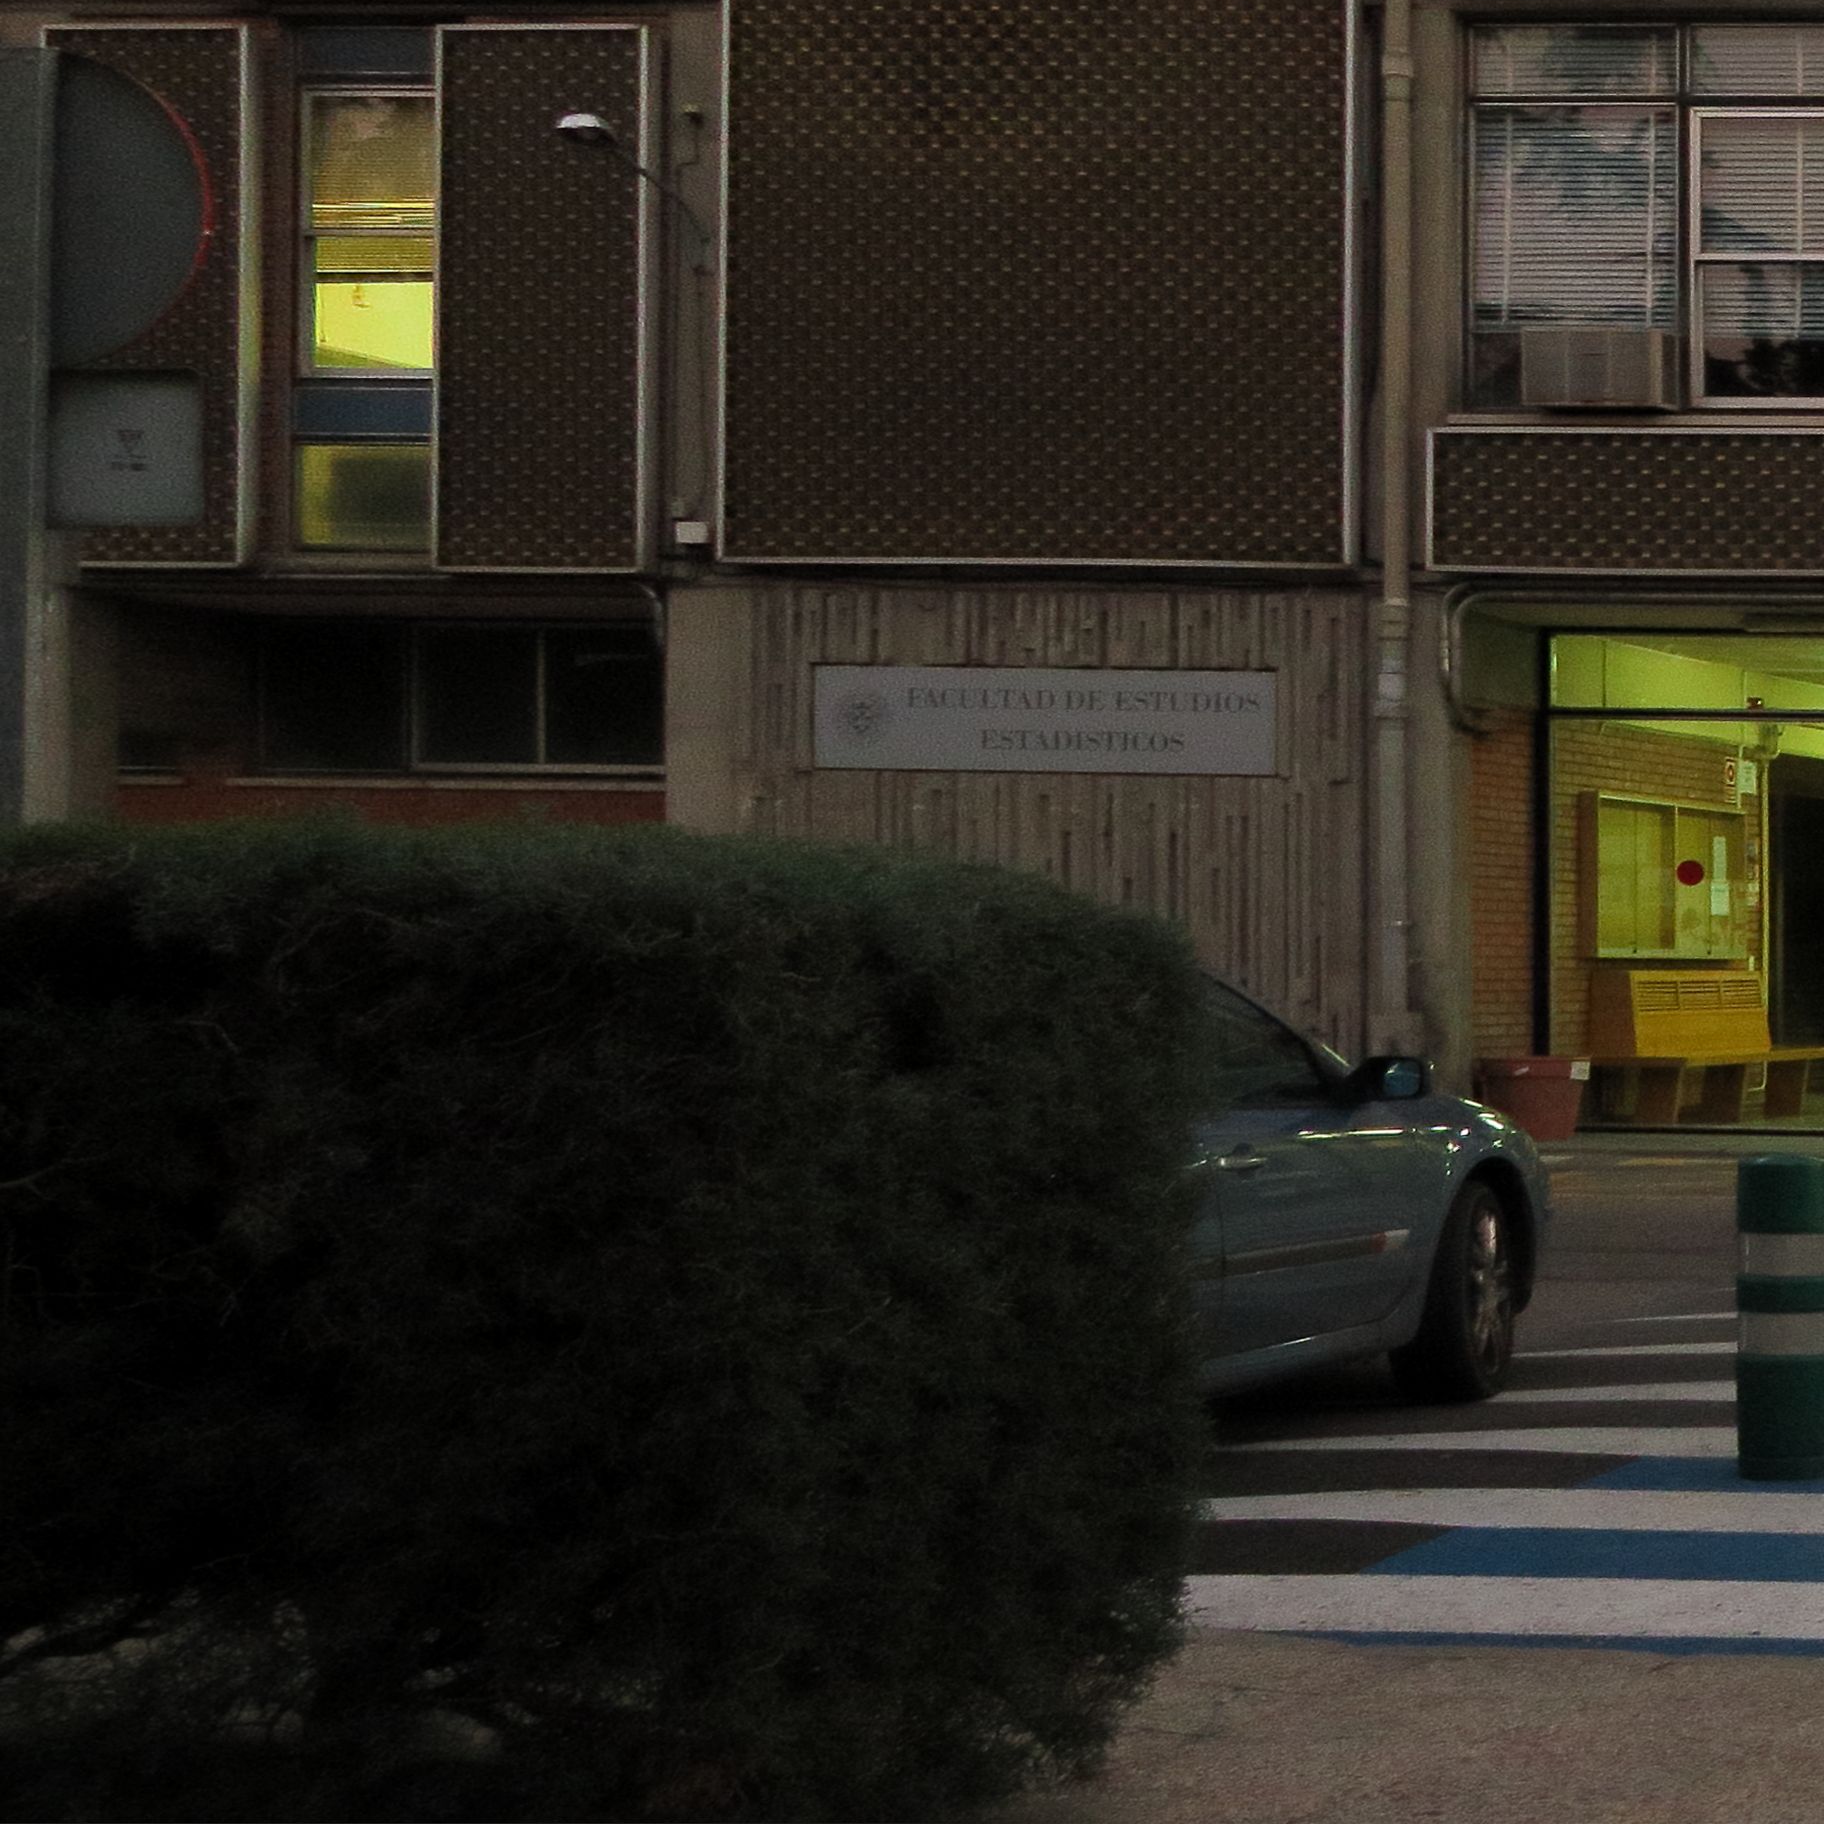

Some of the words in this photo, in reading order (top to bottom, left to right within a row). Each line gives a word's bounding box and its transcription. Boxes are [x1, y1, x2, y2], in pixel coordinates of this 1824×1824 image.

[907, 686, 1056, 711] FACULTAD
[1066, 690, 1106, 712] DE
[1115, 690, 1262, 714] ESTUDIOS
[980, 729, 1186, 753] ESTADISTICOS
